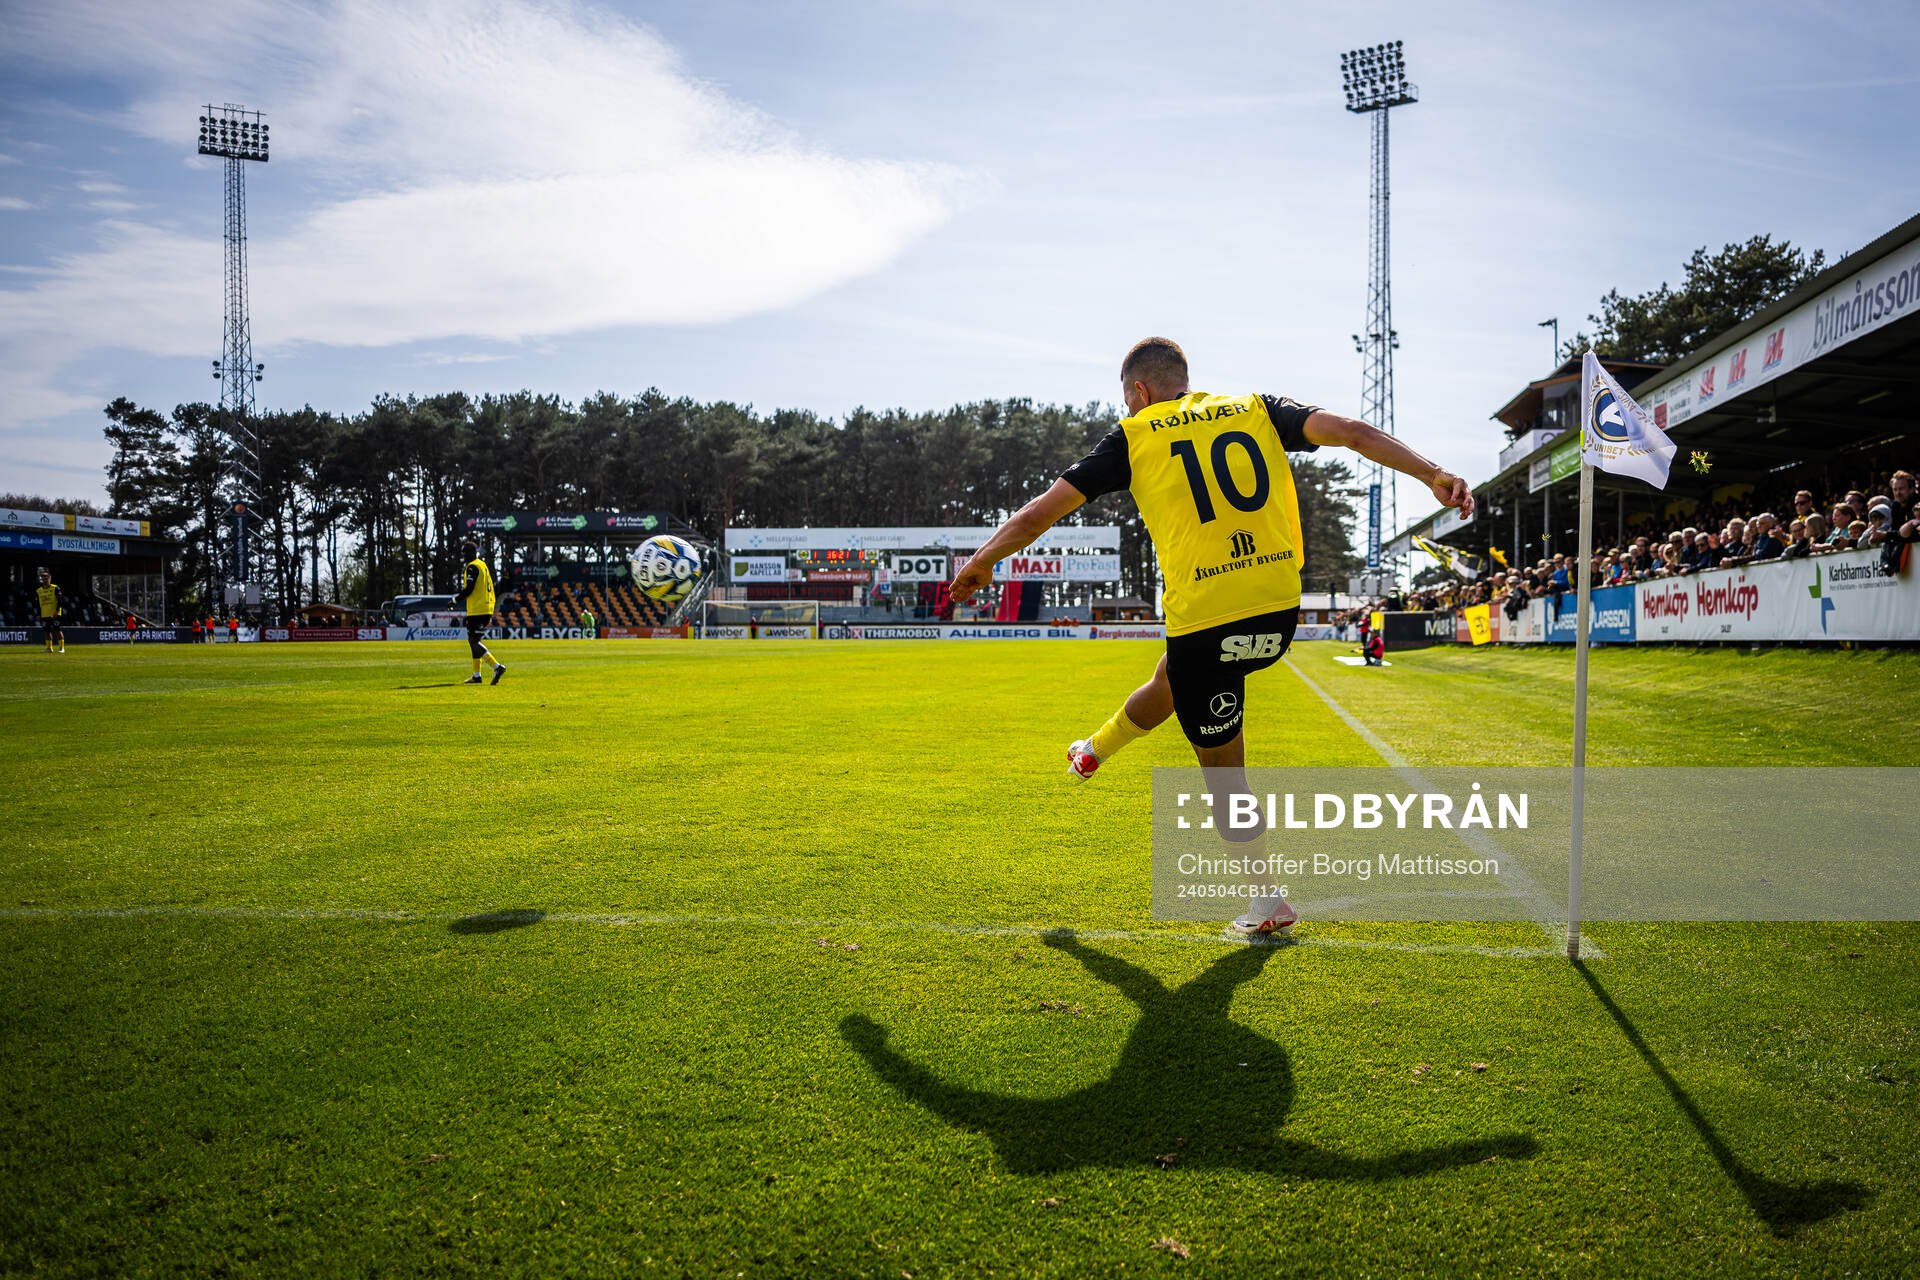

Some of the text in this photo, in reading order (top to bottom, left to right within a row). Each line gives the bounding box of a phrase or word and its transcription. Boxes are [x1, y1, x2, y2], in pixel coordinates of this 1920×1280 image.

[1149, 403, 1249, 433] RØJKJÆR
[1594, 443, 1626, 456] UNIBET
[1170, 430, 1270, 525] 10
[640, 548, 653, 582] SELECT
[750, 562, 781, 570] HANSSON
[1011, 557, 1061, 574] MAXI
[1067, 557, 1118, 572] ProFast
[1194, 549, 1294, 582] JÄRLETOFT BYGGER
[1829, 562, 1872, 582] Karlshamns
[1643, 575, 1759, 623] Hemköp Hemköp
[99, 631, 140, 640] GEMENSKP.
[770, 627, 806, 638] weber
[866, 628, 940, 639] THERMOBOX
[950, 629, 1077, 638] AHLBERG BIL
